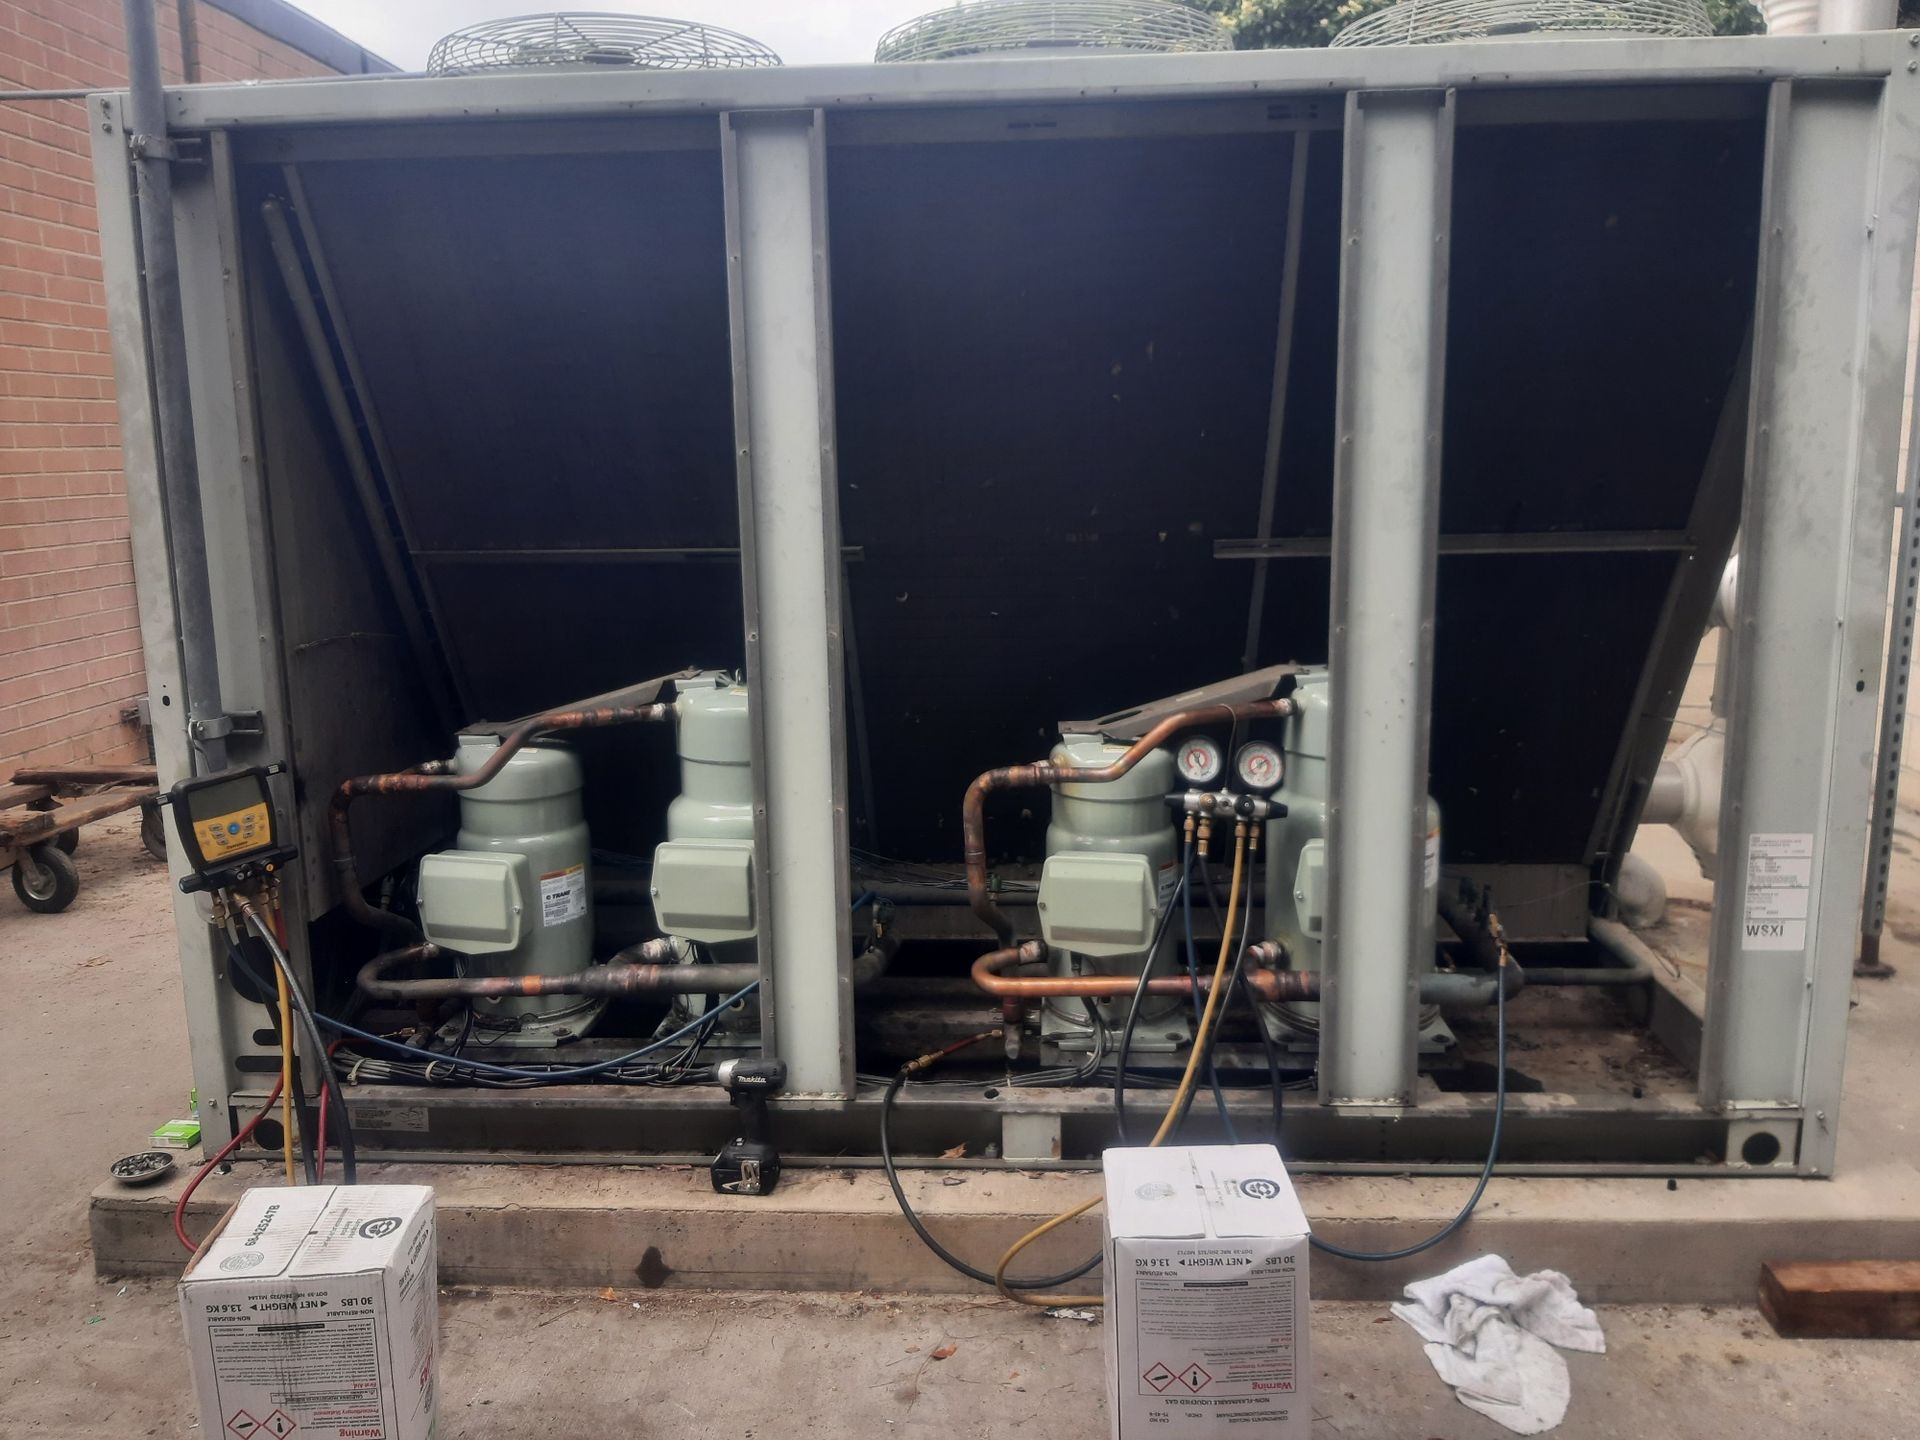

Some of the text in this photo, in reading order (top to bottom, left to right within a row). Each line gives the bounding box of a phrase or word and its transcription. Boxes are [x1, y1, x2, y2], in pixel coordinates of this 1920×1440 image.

[1746, 924, 1784, 937] WSXI
[1135, 1255, 1295, 1267] 30 LBS NET WEIGHT 13.6 KG
[1136, 1269, 1178, 1277] NON-REUSABLE
[205, 1296, 373, 1313] 30 LBS NET WEIGHT 13.6 KG
[207, 1315, 251, 1323] NON-REUSABLE
[1251, 1381, 1293, 1391] Warning
[338, 1428, 382, 1439] Warning
